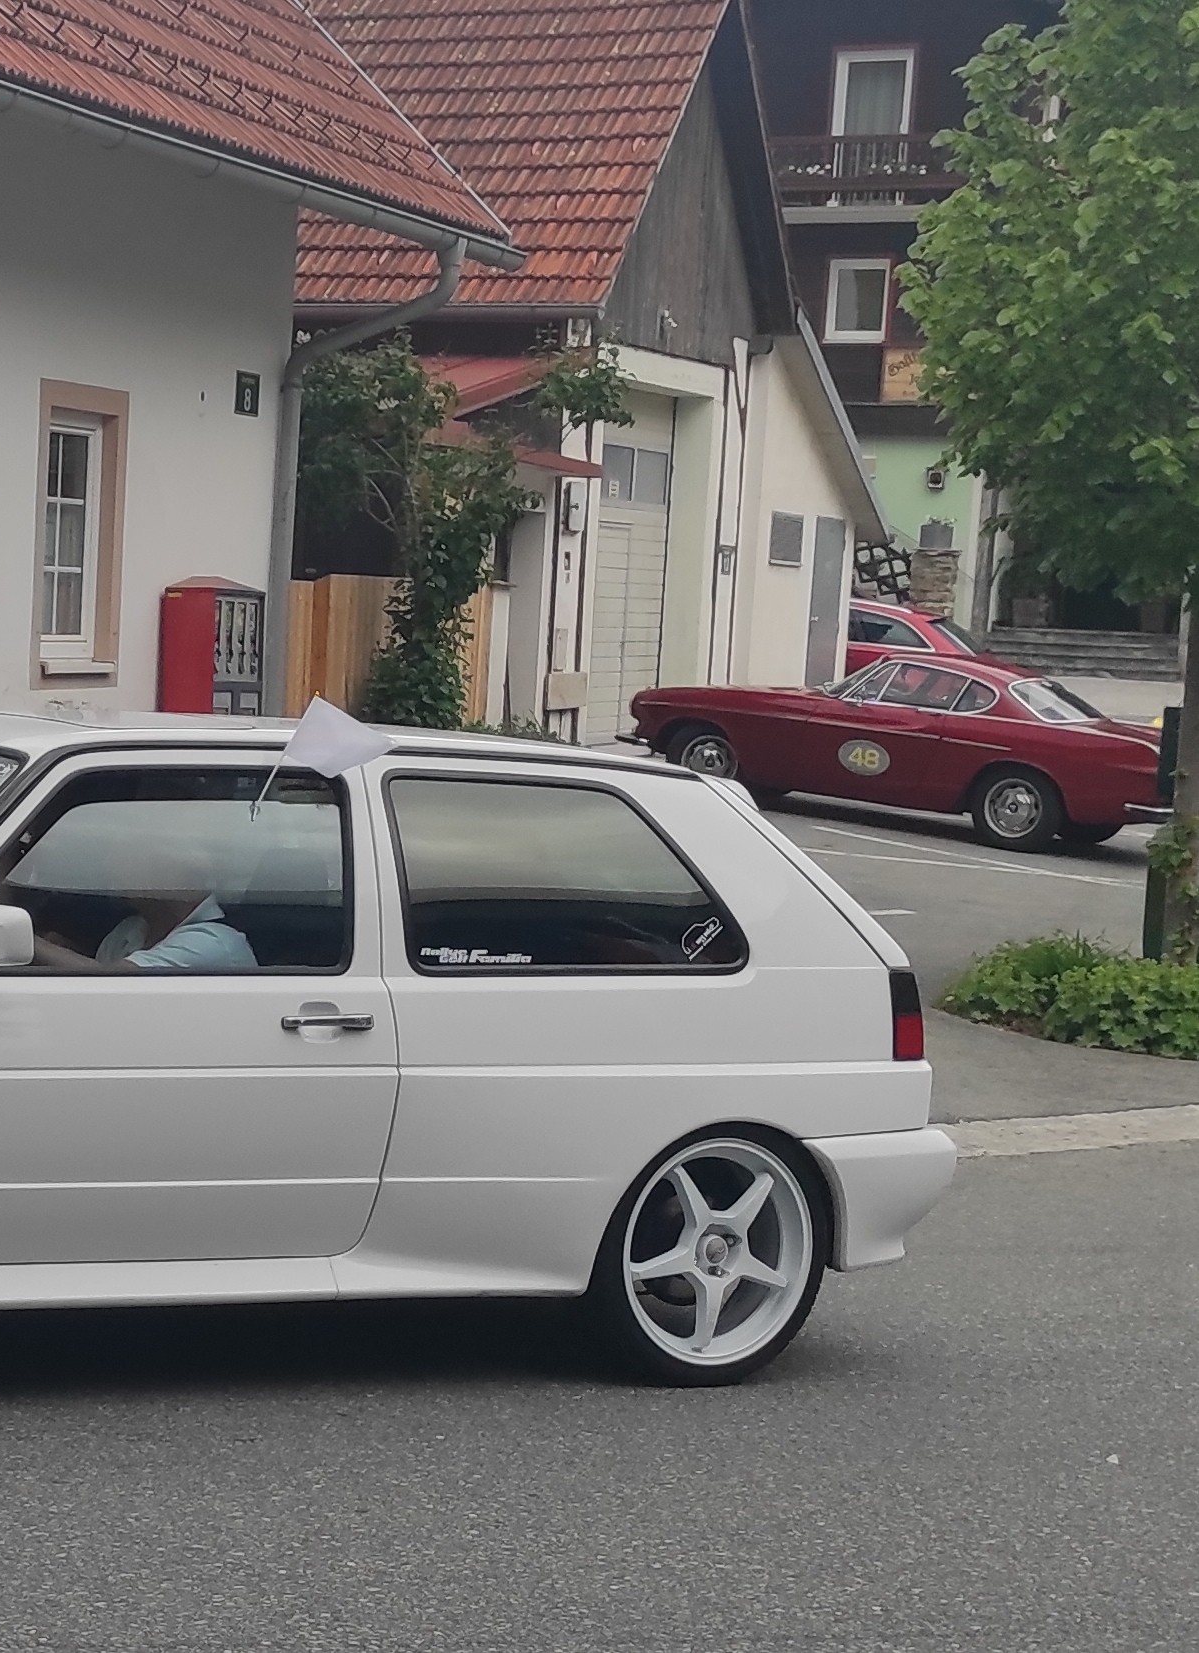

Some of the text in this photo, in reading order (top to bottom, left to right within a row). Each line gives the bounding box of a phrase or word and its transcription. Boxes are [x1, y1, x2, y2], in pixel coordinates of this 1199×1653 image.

[244, 388, 252, 411] 8
[848, 746, 880, 769] 48
[469, 949, 532, 963] Familia
